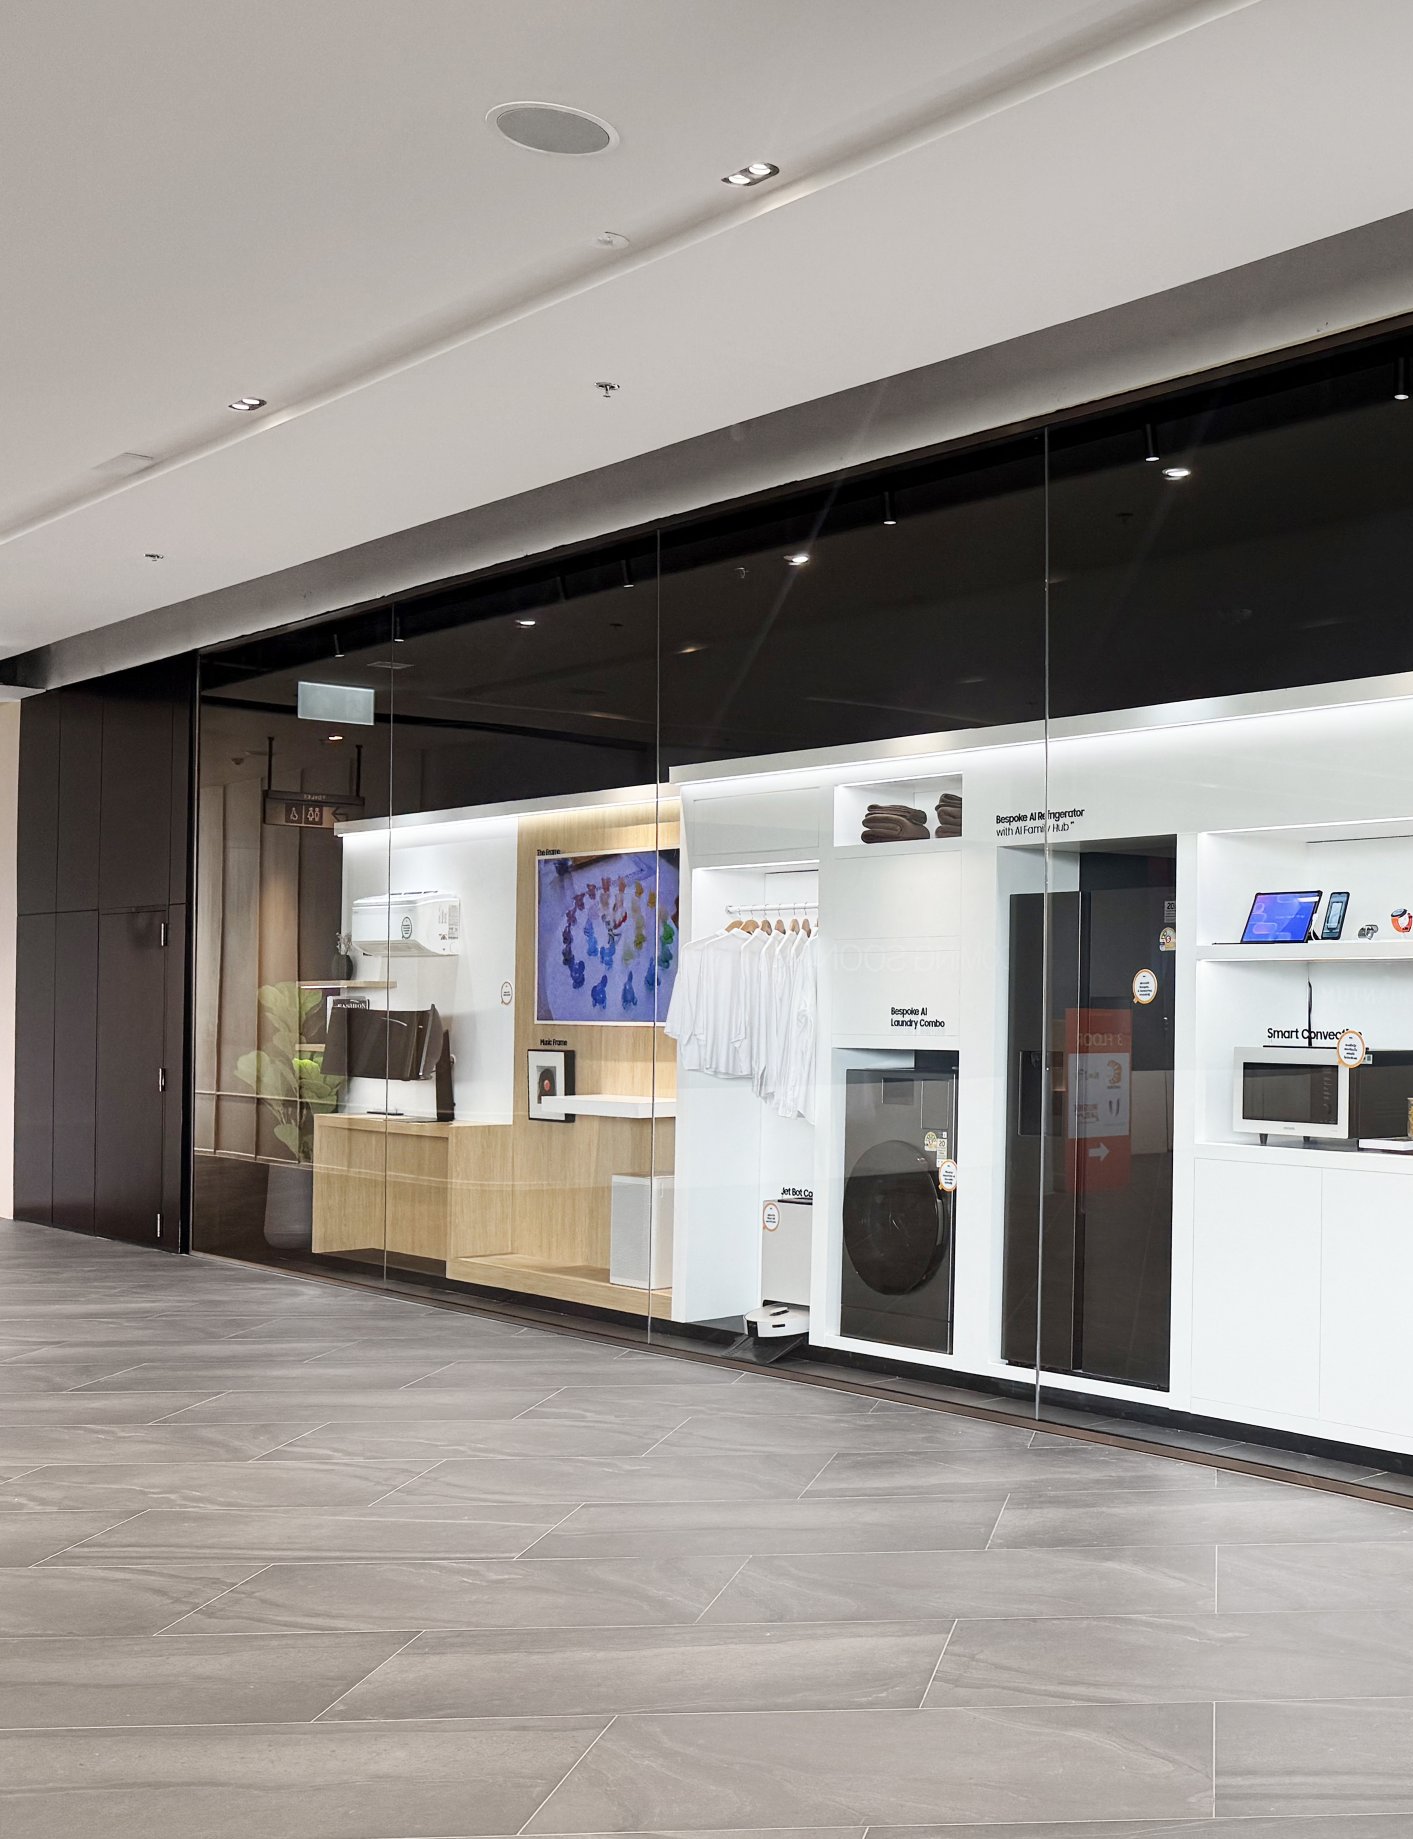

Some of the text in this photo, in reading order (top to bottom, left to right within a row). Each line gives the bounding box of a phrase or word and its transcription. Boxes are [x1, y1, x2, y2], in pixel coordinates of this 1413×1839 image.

[995, 813, 1028, 825] Bespoke
[1029, 811, 1037, 821] AI
[996, 826, 1014, 836] with
[1023, 823, 1050, 835] Famiy
[890, 1006, 928, 1018] Bespoke AI
[890, 1018, 946, 1030] Laundry Combo
[1267, 1028, 1362, 1040] Smart Convec
[781, 1187, 791, 1196] Jet
[791, 1188, 803, 1197] Bot
